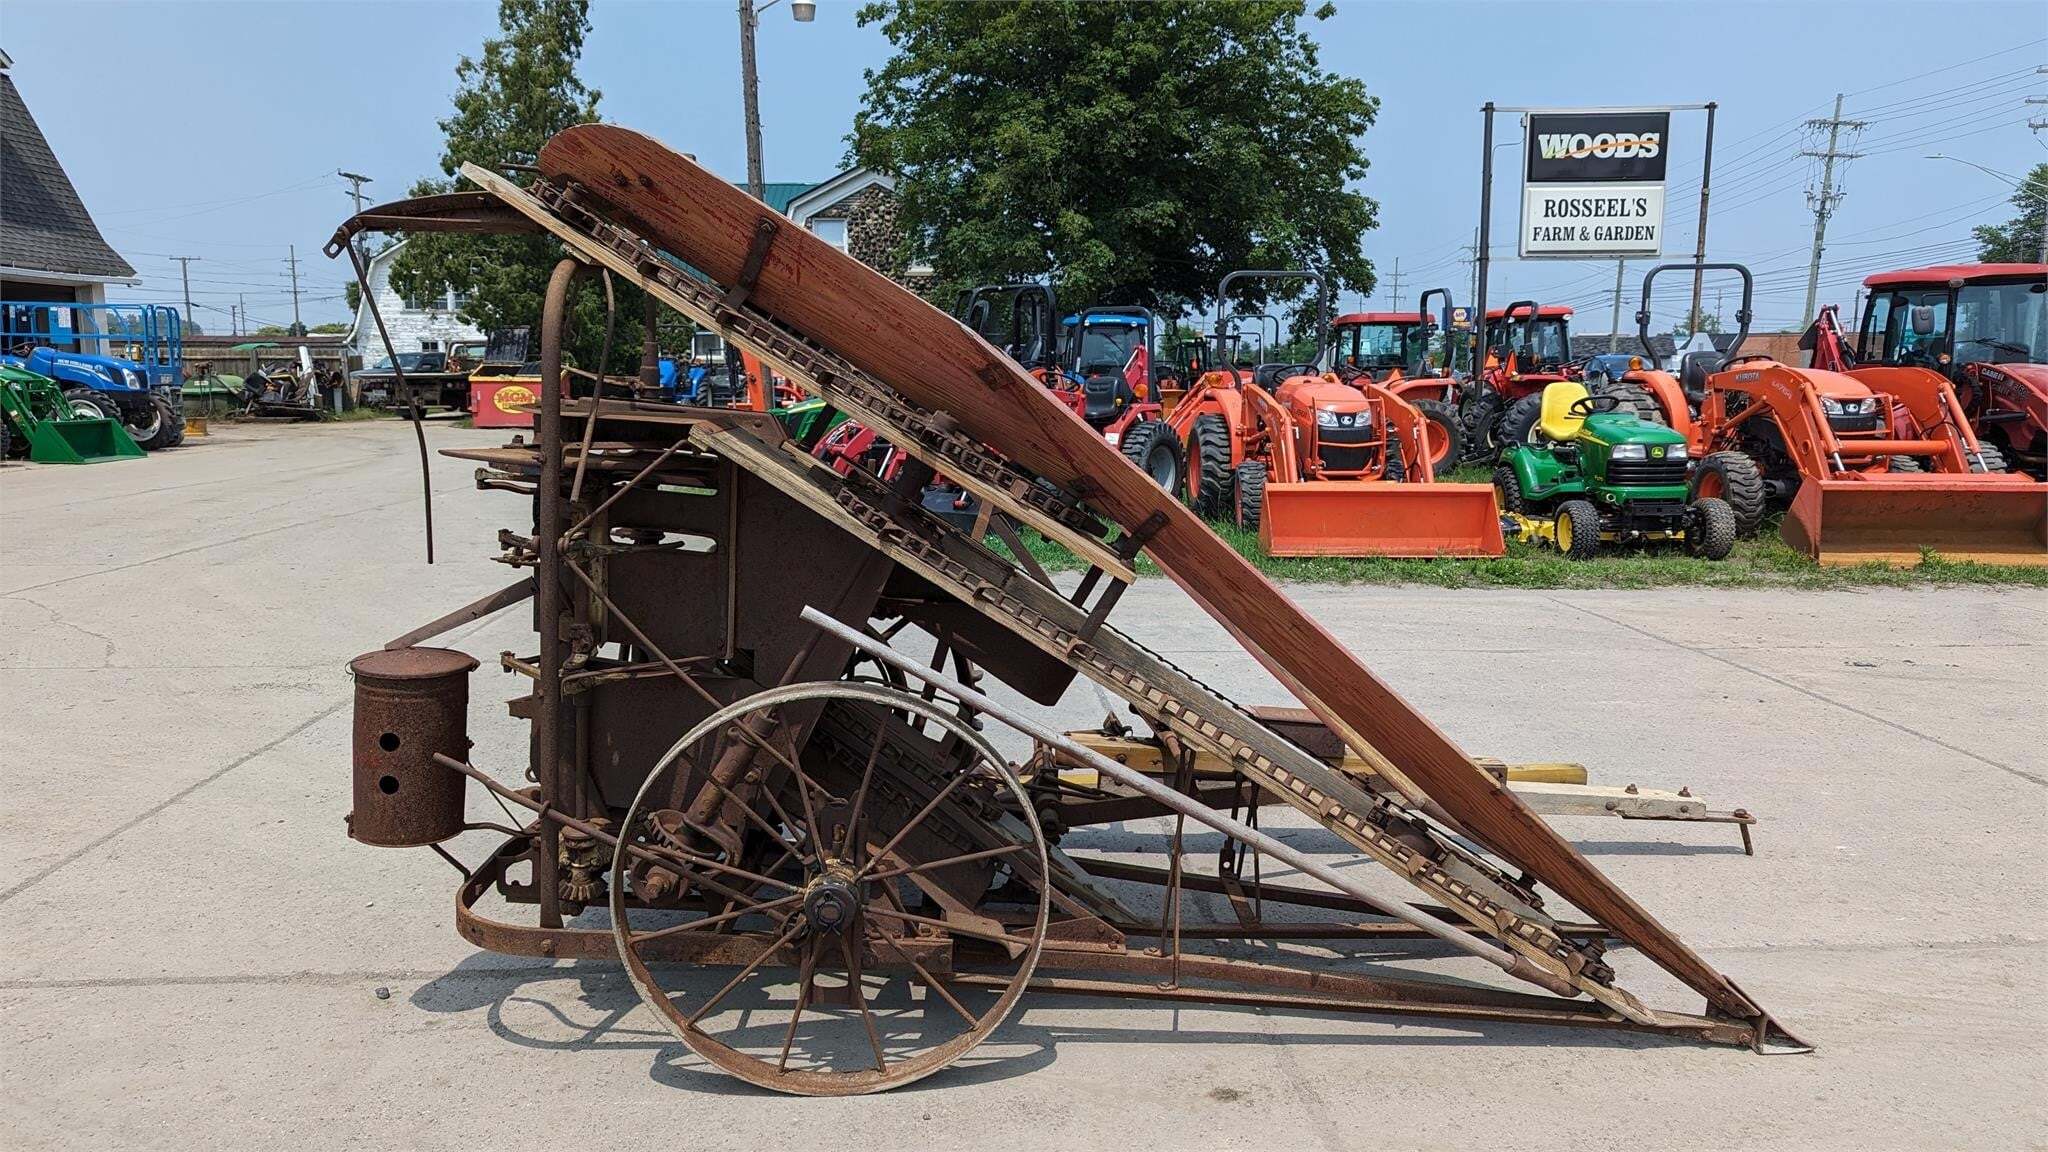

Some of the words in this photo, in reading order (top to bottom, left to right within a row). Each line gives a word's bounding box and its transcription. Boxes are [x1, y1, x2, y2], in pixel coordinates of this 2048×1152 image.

[1538, 133, 1660, 159] WOODS
[1543, 198, 1648, 218] ROSSEEL'S
[1532, 226, 1576, 242] FARM
[1579, 226, 1591, 242] &
[1594, 225, 1656, 241] GARDEN
[496, 391, 533, 403] MGM
